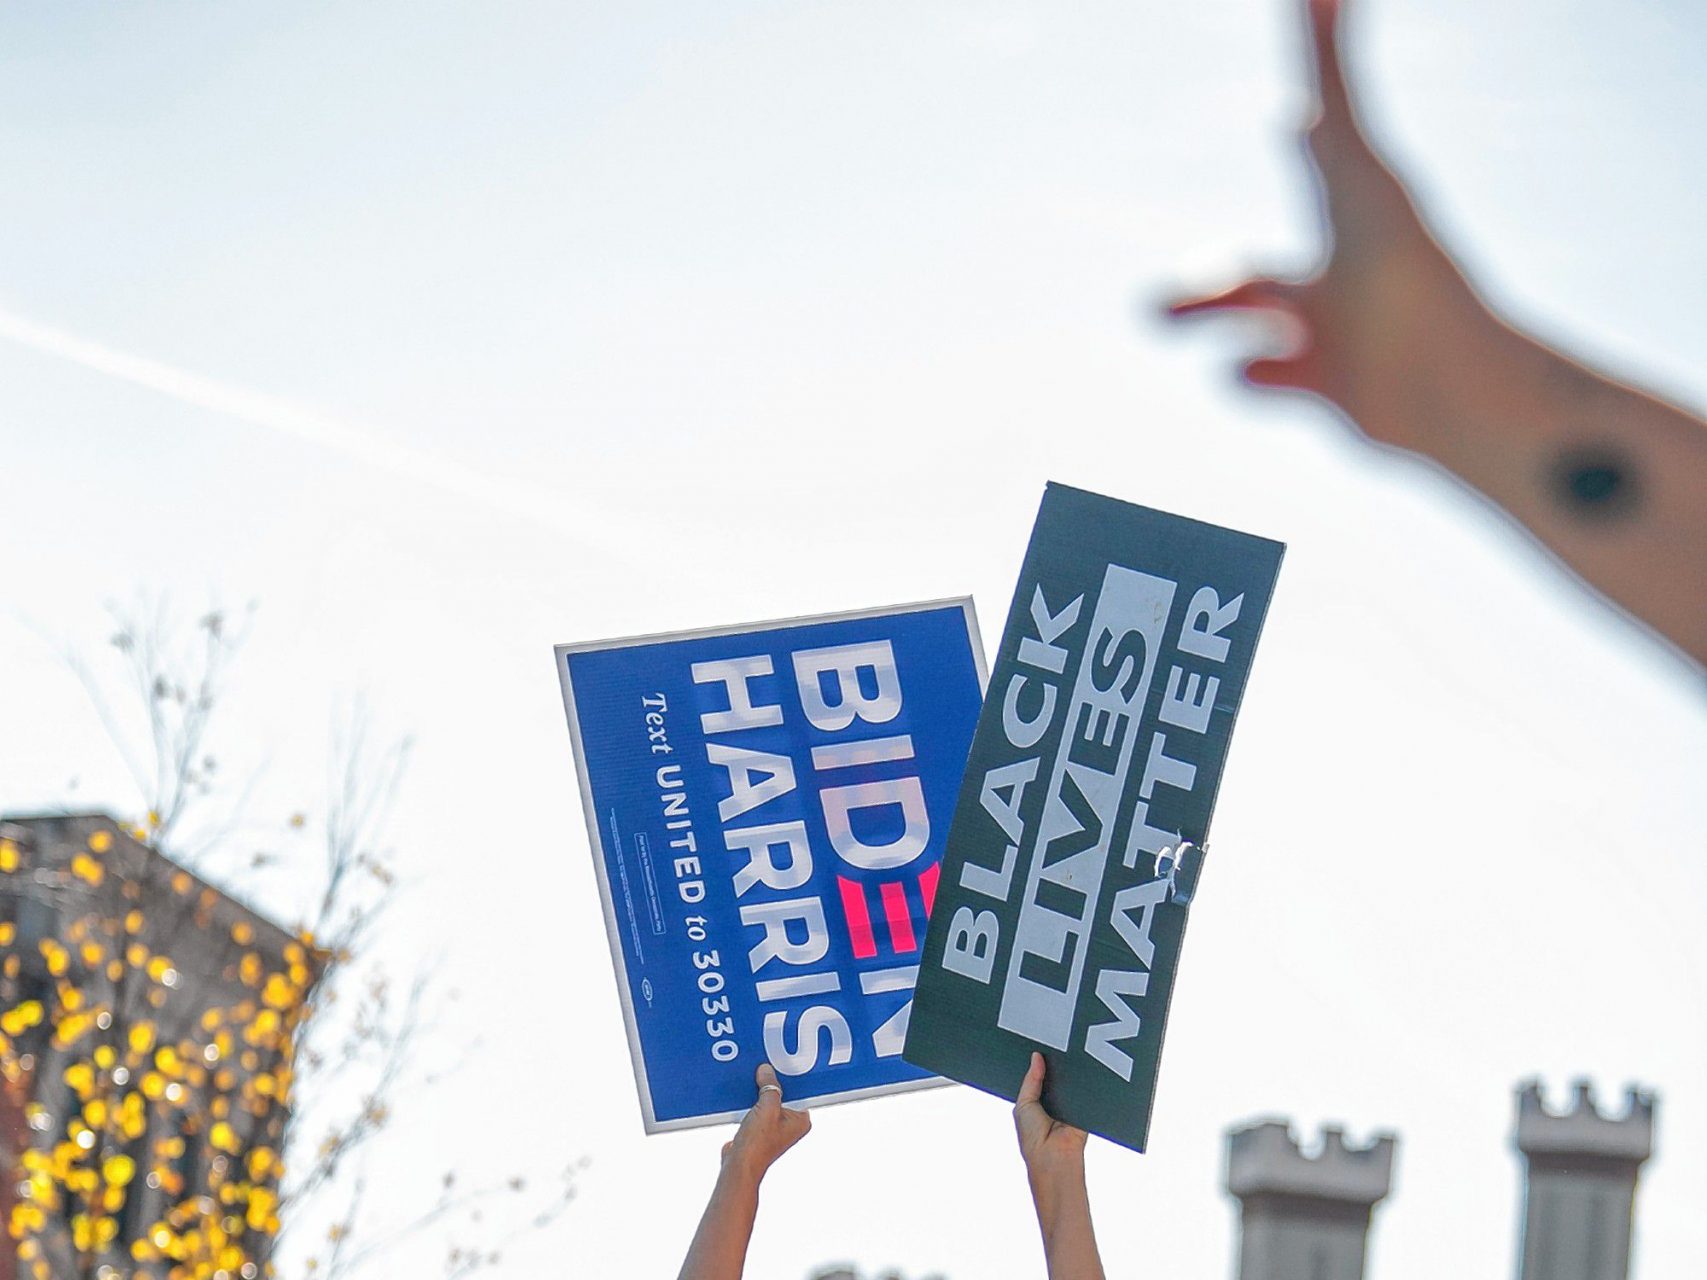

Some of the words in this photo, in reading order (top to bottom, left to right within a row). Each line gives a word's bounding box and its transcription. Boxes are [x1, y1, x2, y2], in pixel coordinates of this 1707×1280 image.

[641, 692, 673, 754] Text
[656, 764, 706, 904] UNITED
[942, 583, 1085, 985] BLACK
[1018, 626, 1149, 995] LIVES
[1084, 585, 1246, 1083] MATTER
[684, 915, 708, 942] to
[691, 655, 853, 1077] HARRIS
[692, 949, 739, 1062] 30330
